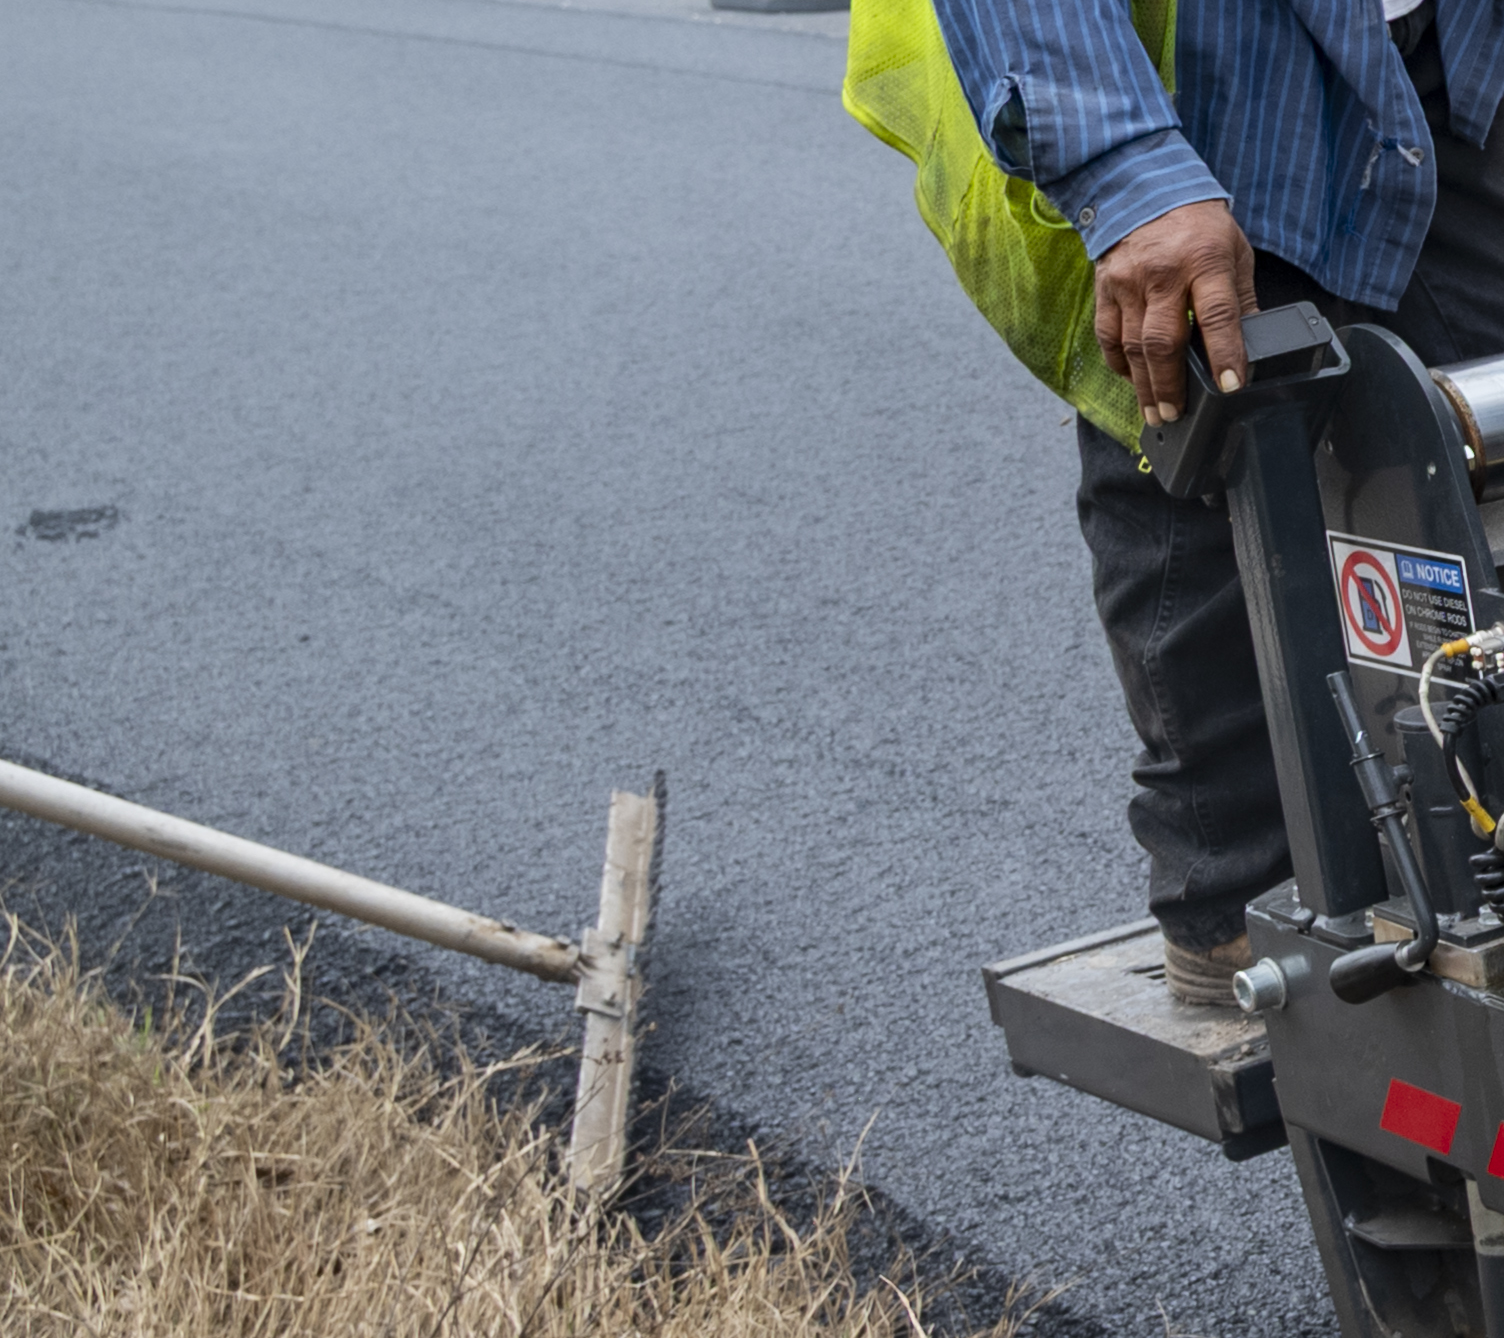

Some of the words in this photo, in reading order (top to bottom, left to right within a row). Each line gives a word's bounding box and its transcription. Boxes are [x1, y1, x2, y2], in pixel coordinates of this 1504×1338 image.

[1416, 563, 1460, 587] NOTICE
[1402, 588, 1412, 599] DO
[1413, 591, 1428, 603] NOT
[1428, 595, 1443, 606] USE
[1443, 597, 1467, 612] DIESEL
[1405, 604, 1416, 615] ON
[1417, 607, 1446, 622] CHROME
[1447, 612, 1467, 627] RODS
